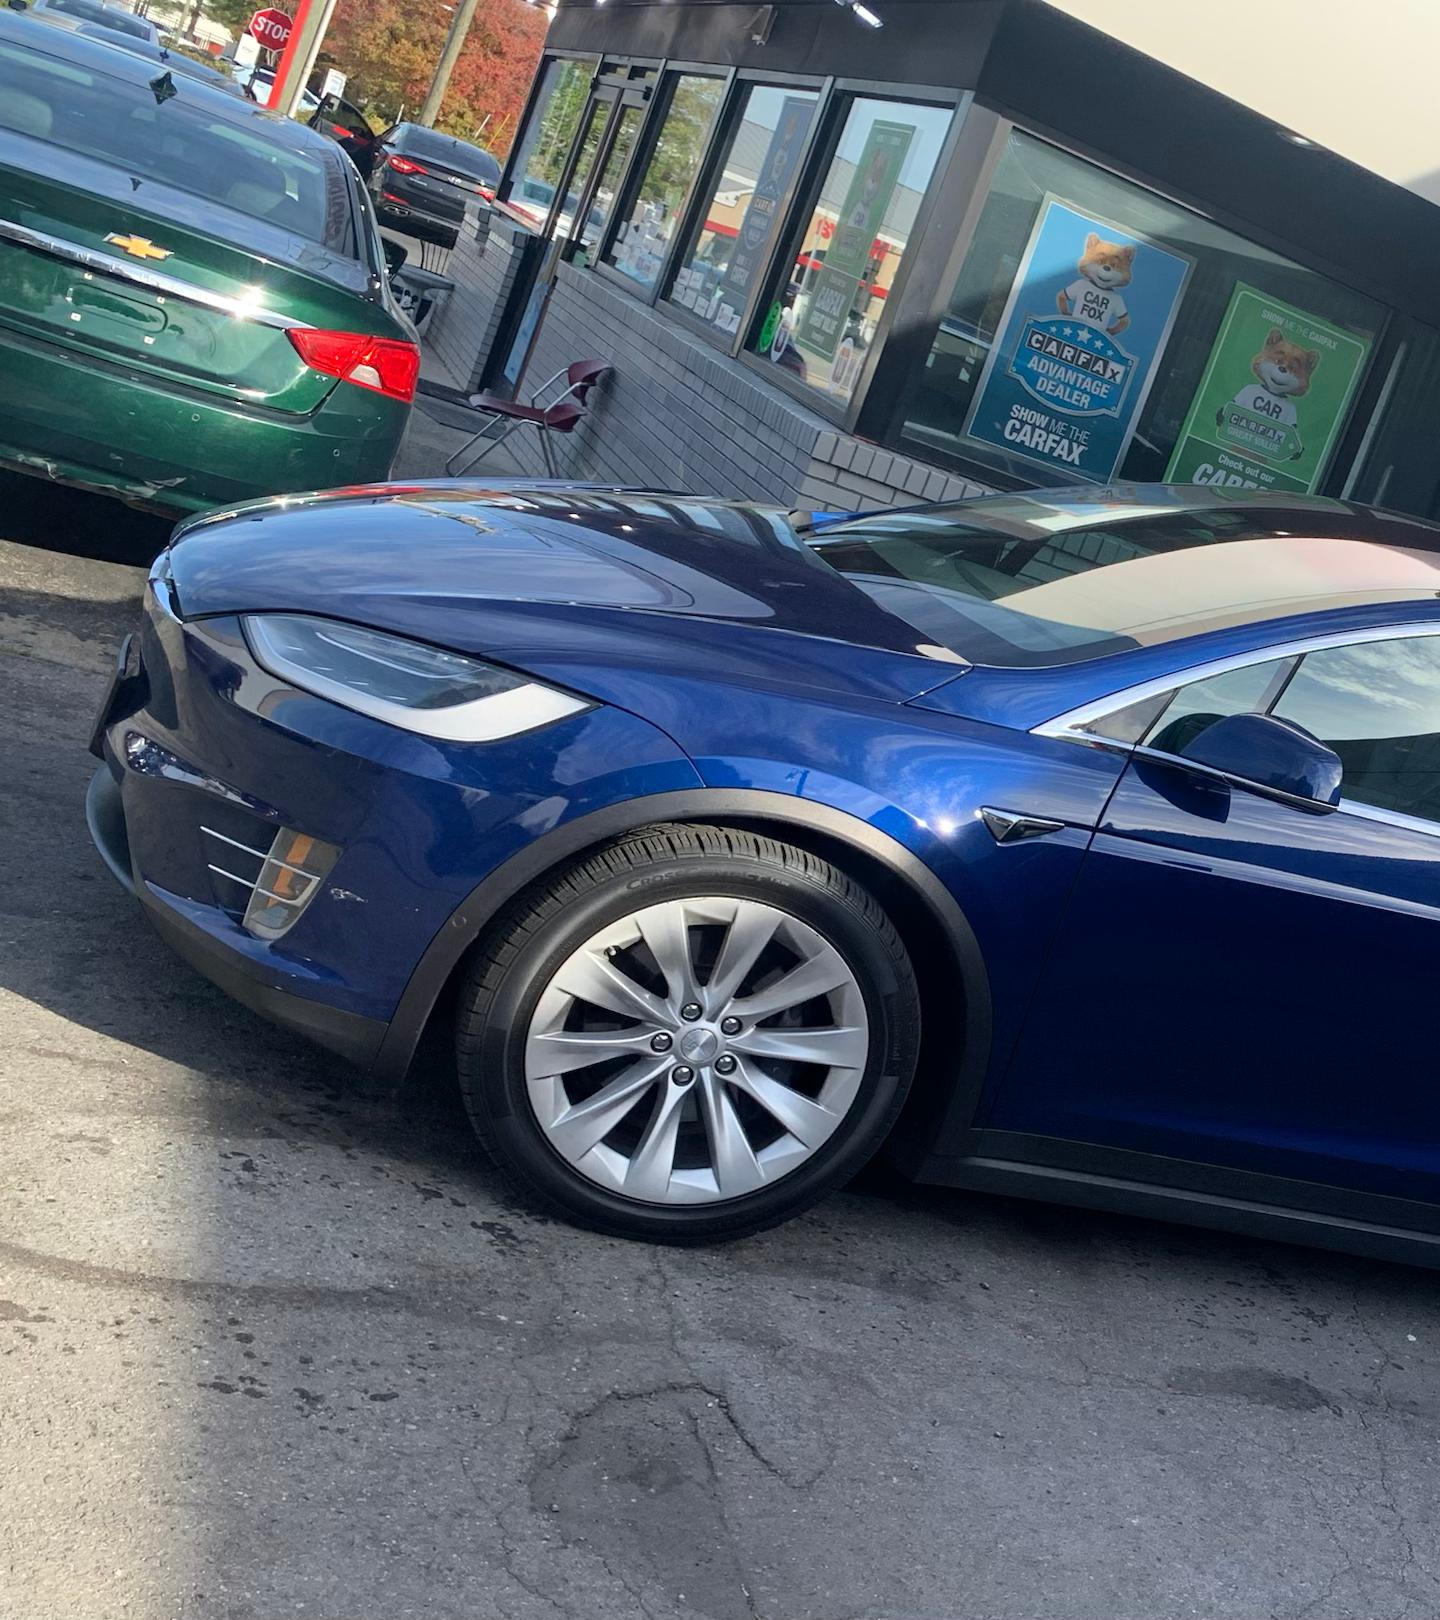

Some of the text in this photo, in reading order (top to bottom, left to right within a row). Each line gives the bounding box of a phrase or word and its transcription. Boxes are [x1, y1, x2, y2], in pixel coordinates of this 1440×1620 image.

[254, 16, 291, 42] STOP
[1080, 304, 1105, 322] FOX
[1084, 291, 1110, 310] CAR
[1029, 332, 1122, 383] CARFAX
[1027, 354, 1111, 398] ADVANTAGE
[1036, 376, 1091, 409] DEALER
[1253, 396, 1282, 419] CAR
[1010, 404, 1091, 446] SHOW ME THE
[1229, 413, 1285, 443] CARFAX
[1004, 419, 1086, 466] CARFAX
[1218, 454, 1275, 483] Check out our
